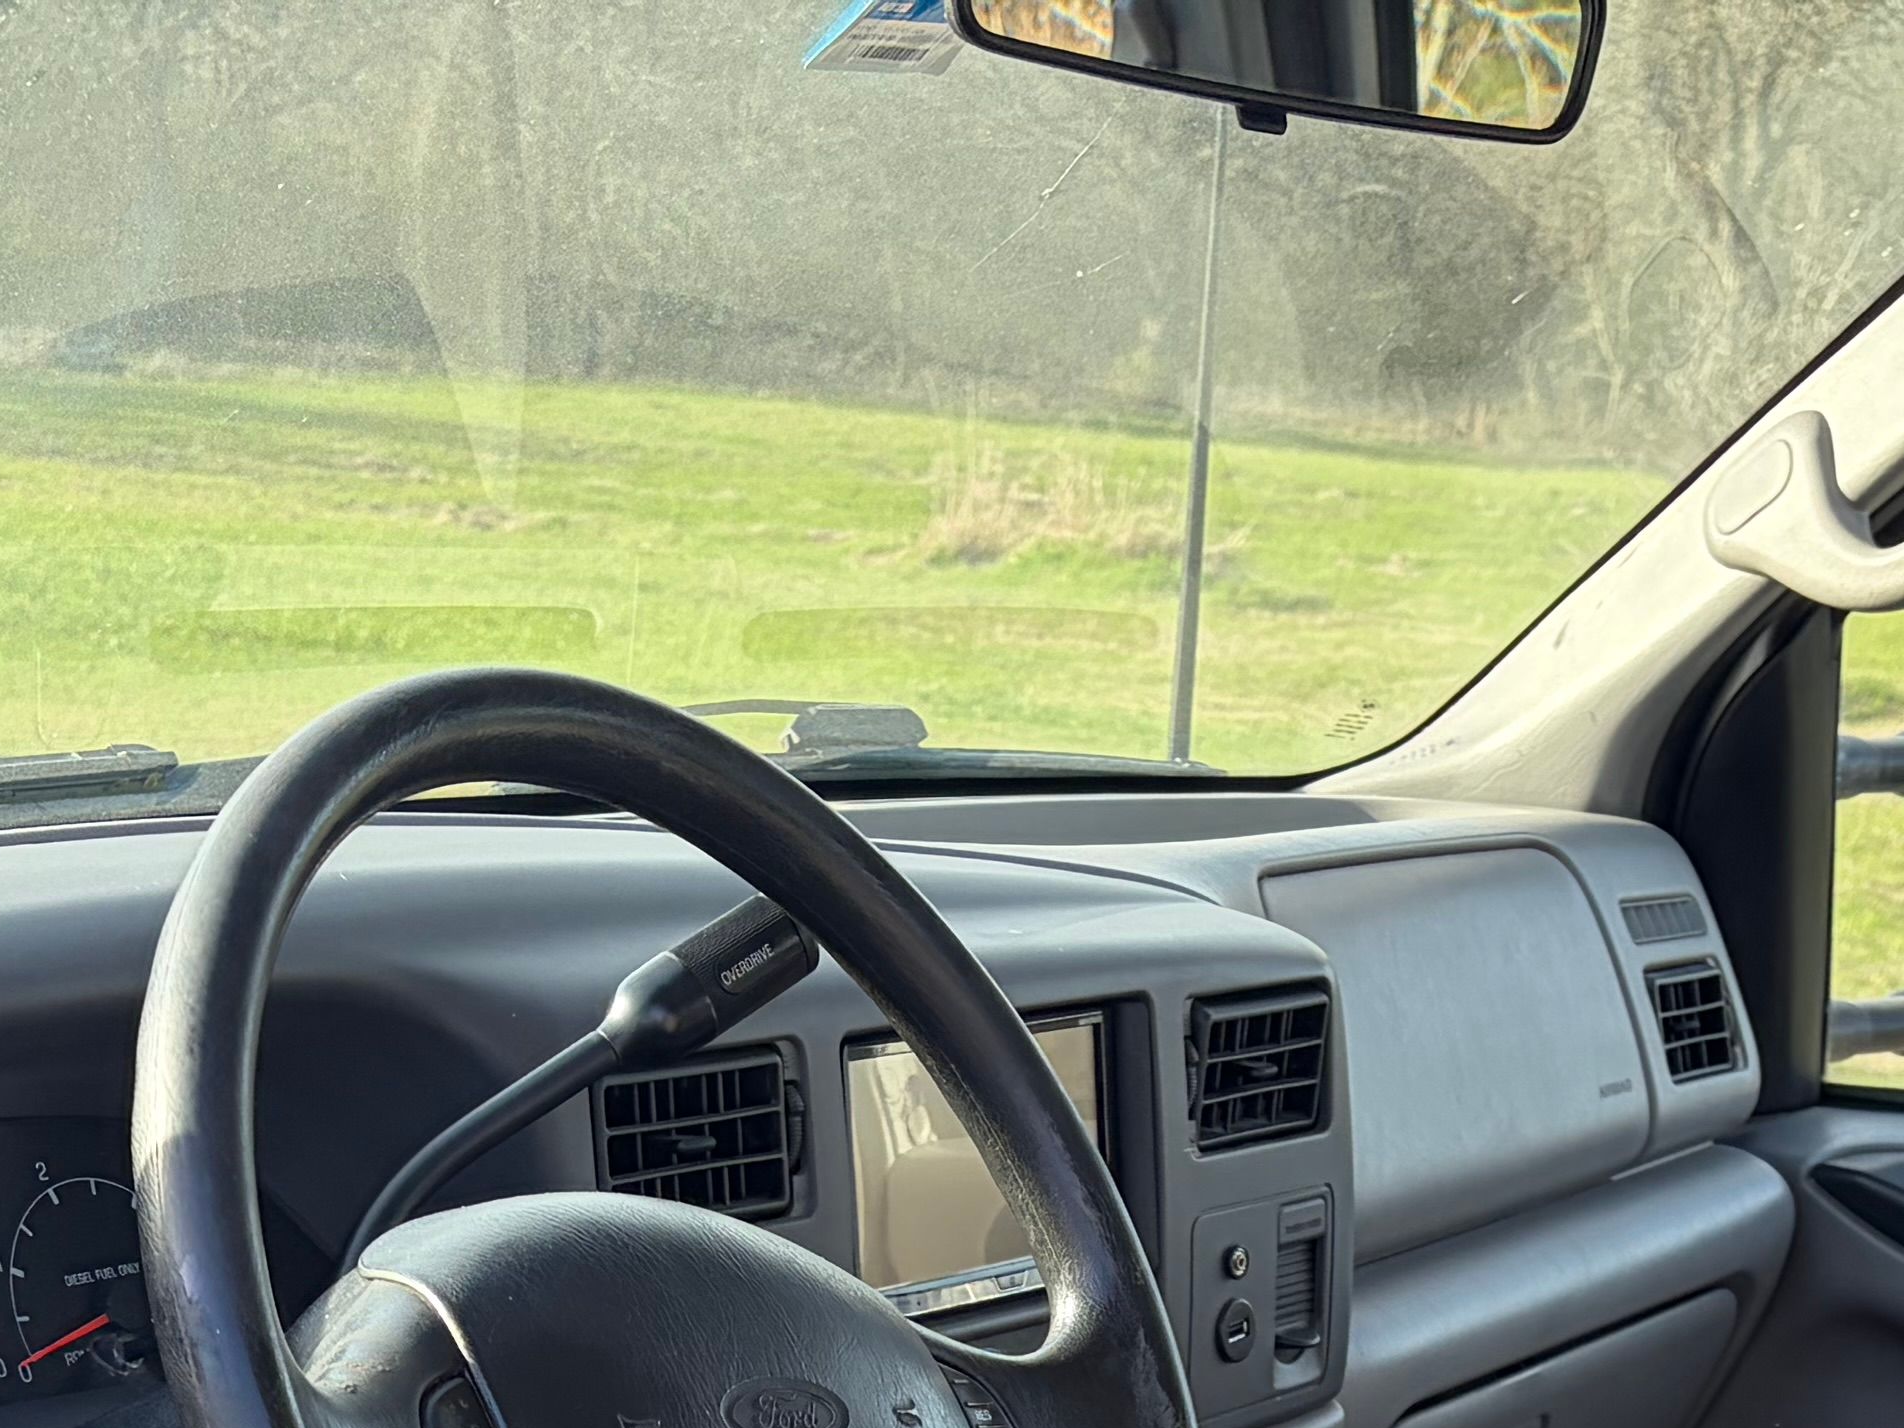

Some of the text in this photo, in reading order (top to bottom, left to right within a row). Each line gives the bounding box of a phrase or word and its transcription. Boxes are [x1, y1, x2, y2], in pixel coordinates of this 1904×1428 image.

[719, 943, 775, 986] OVERDRIVE
[35, 1161, 49, 1181] 2
[63, 1262, 141, 1287] DIESEL FUEL ONLY
[18, 1362, 33, 1383] 0
